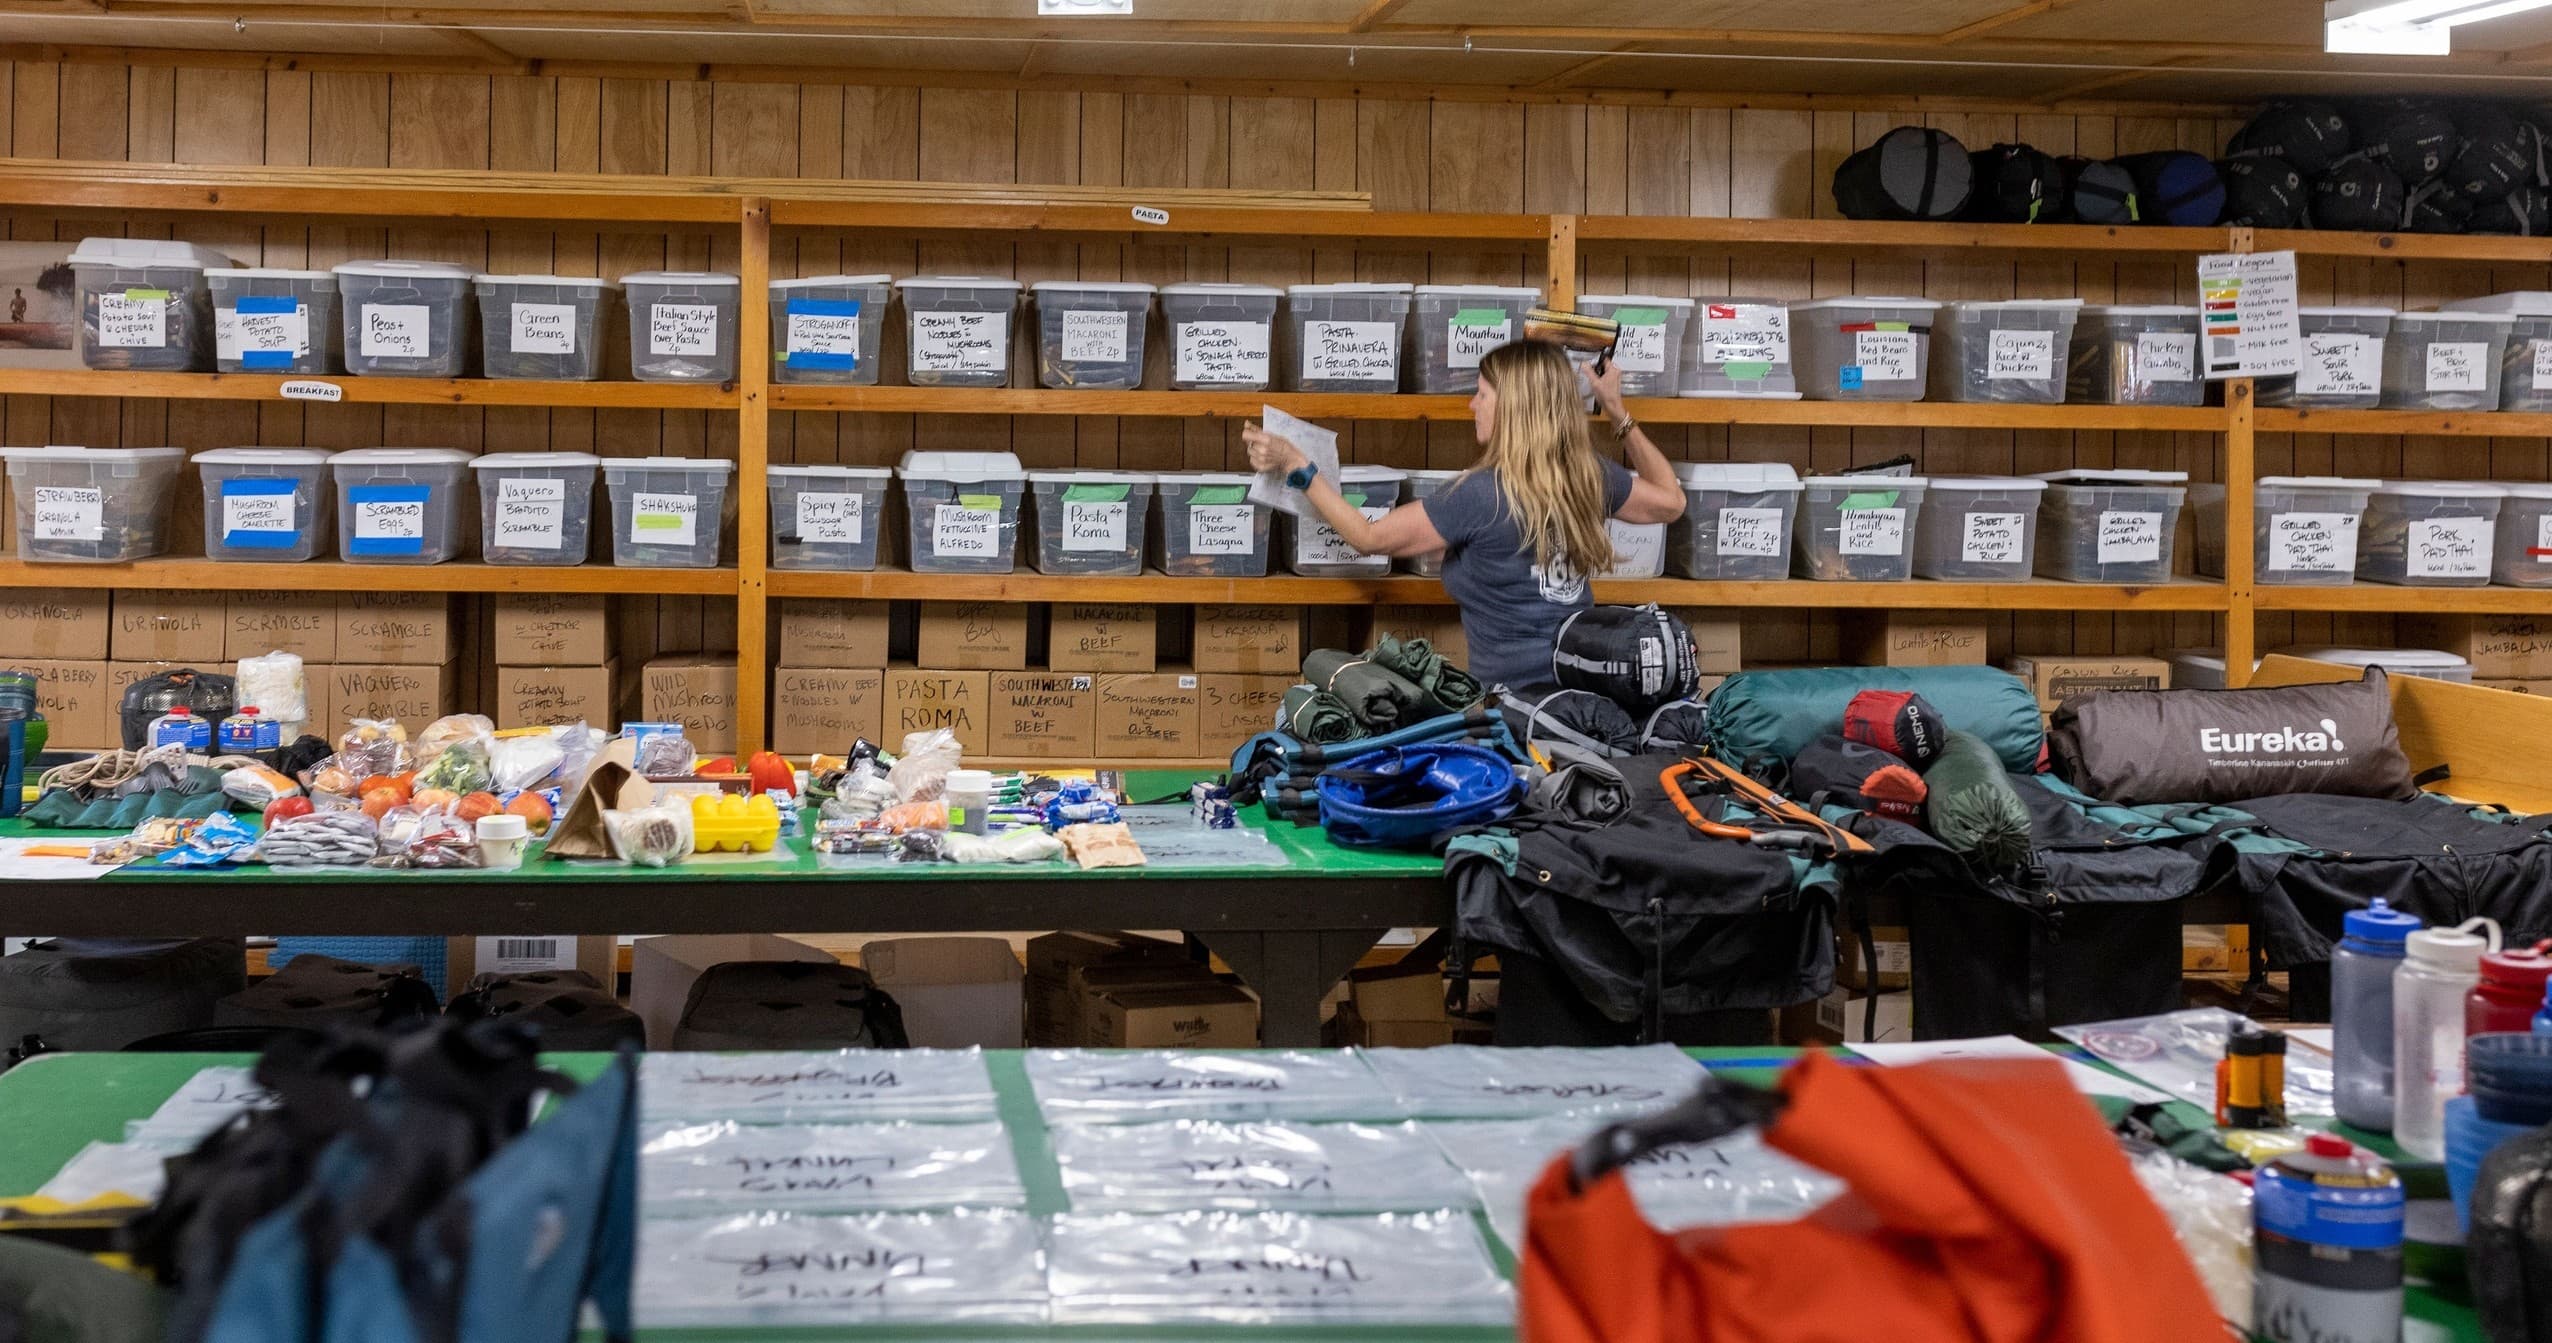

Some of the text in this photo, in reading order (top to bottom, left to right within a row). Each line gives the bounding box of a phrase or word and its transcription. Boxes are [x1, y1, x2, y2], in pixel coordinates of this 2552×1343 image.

[1135, 209, 1163, 220] PASTA
[520, 310, 560, 325] Green
[374, 332, 412, 345] Onions
[526, 326, 565, 339] Beans
[1067, 329, 1118, 339] MACARONI
[1455, 325, 1505, 341] Mountain
[1071, 348, 1103, 358] BEEF
[286, 386, 341, 398] BREAKFAST
[505, 484, 554, 500] Vaquero
[801, 495, 836, 513] Spicy
[1070, 505, 1108, 525] Pasta
[1193, 510, 1224, 523] Three
[1725, 512, 1760, 526] Pepper
[1073, 525, 1111, 539] Roma
[1199, 522, 1237, 534] Cheese
[1199, 534, 1244, 550] Lasagna
[5, 603, 84, 622] GRANOLA
[122, 615, 203, 633] GRANOLA
[1080, 635, 1122, 651] BEEF
[341, 673, 421, 697] VAQUERO
[897, 679, 970, 700] PASTA
[1012, 695, 1076, 708] MACARONI
[1102, 688, 1196, 705] SOUTHWESTERN
[1208, 688, 1281, 706] 3 CHEES
[901, 707, 973, 731] ROMA
[1129, 706, 1179, 718] MACARONI
[1015, 720, 1056, 733] BEEF
[1907, 704, 1928, 746] NEMO
[2200, 718, 2345, 752] Eureka!
